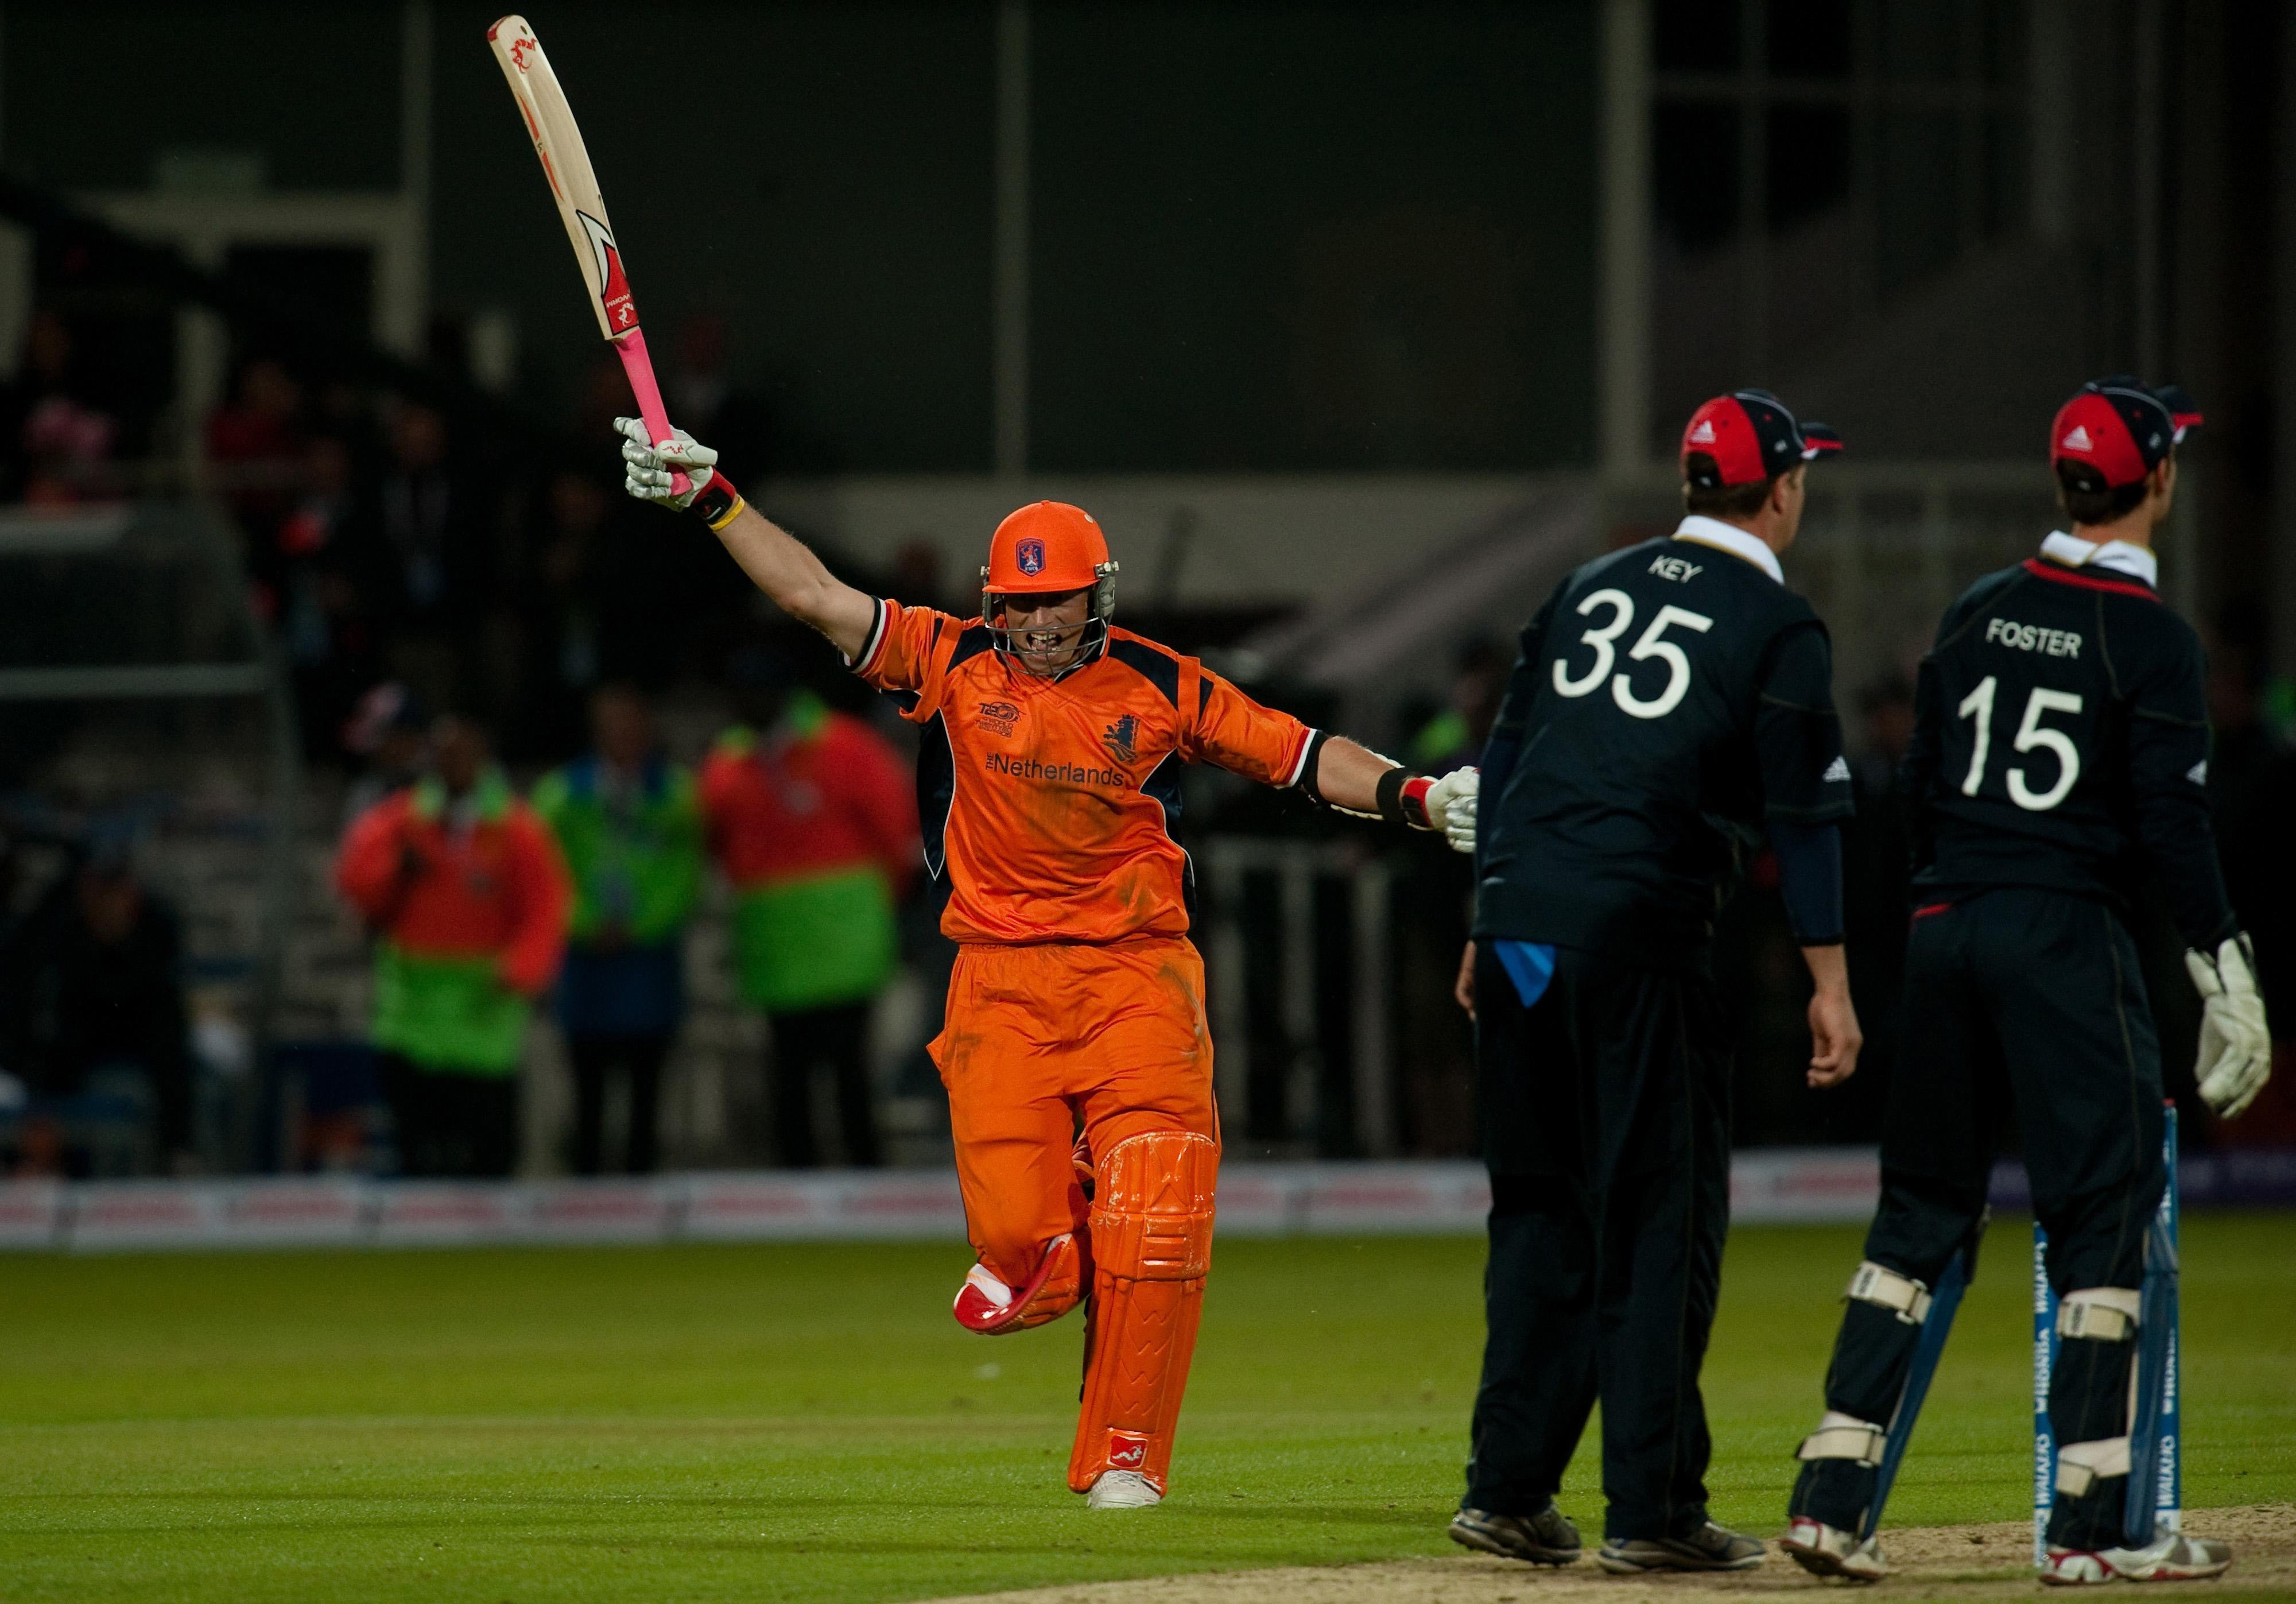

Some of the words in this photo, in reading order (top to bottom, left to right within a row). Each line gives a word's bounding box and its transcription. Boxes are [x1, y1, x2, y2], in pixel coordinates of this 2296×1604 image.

[1647, 555, 1704, 584] KEY
[1552, 588, 1714, 719] 35
[1985, 617, 2083, 659] FOSTER
[1957, 675, 2084, 811] 15
[986, 752, 995, 770] THE
[994, 753, 1123, 786] Netherlands
